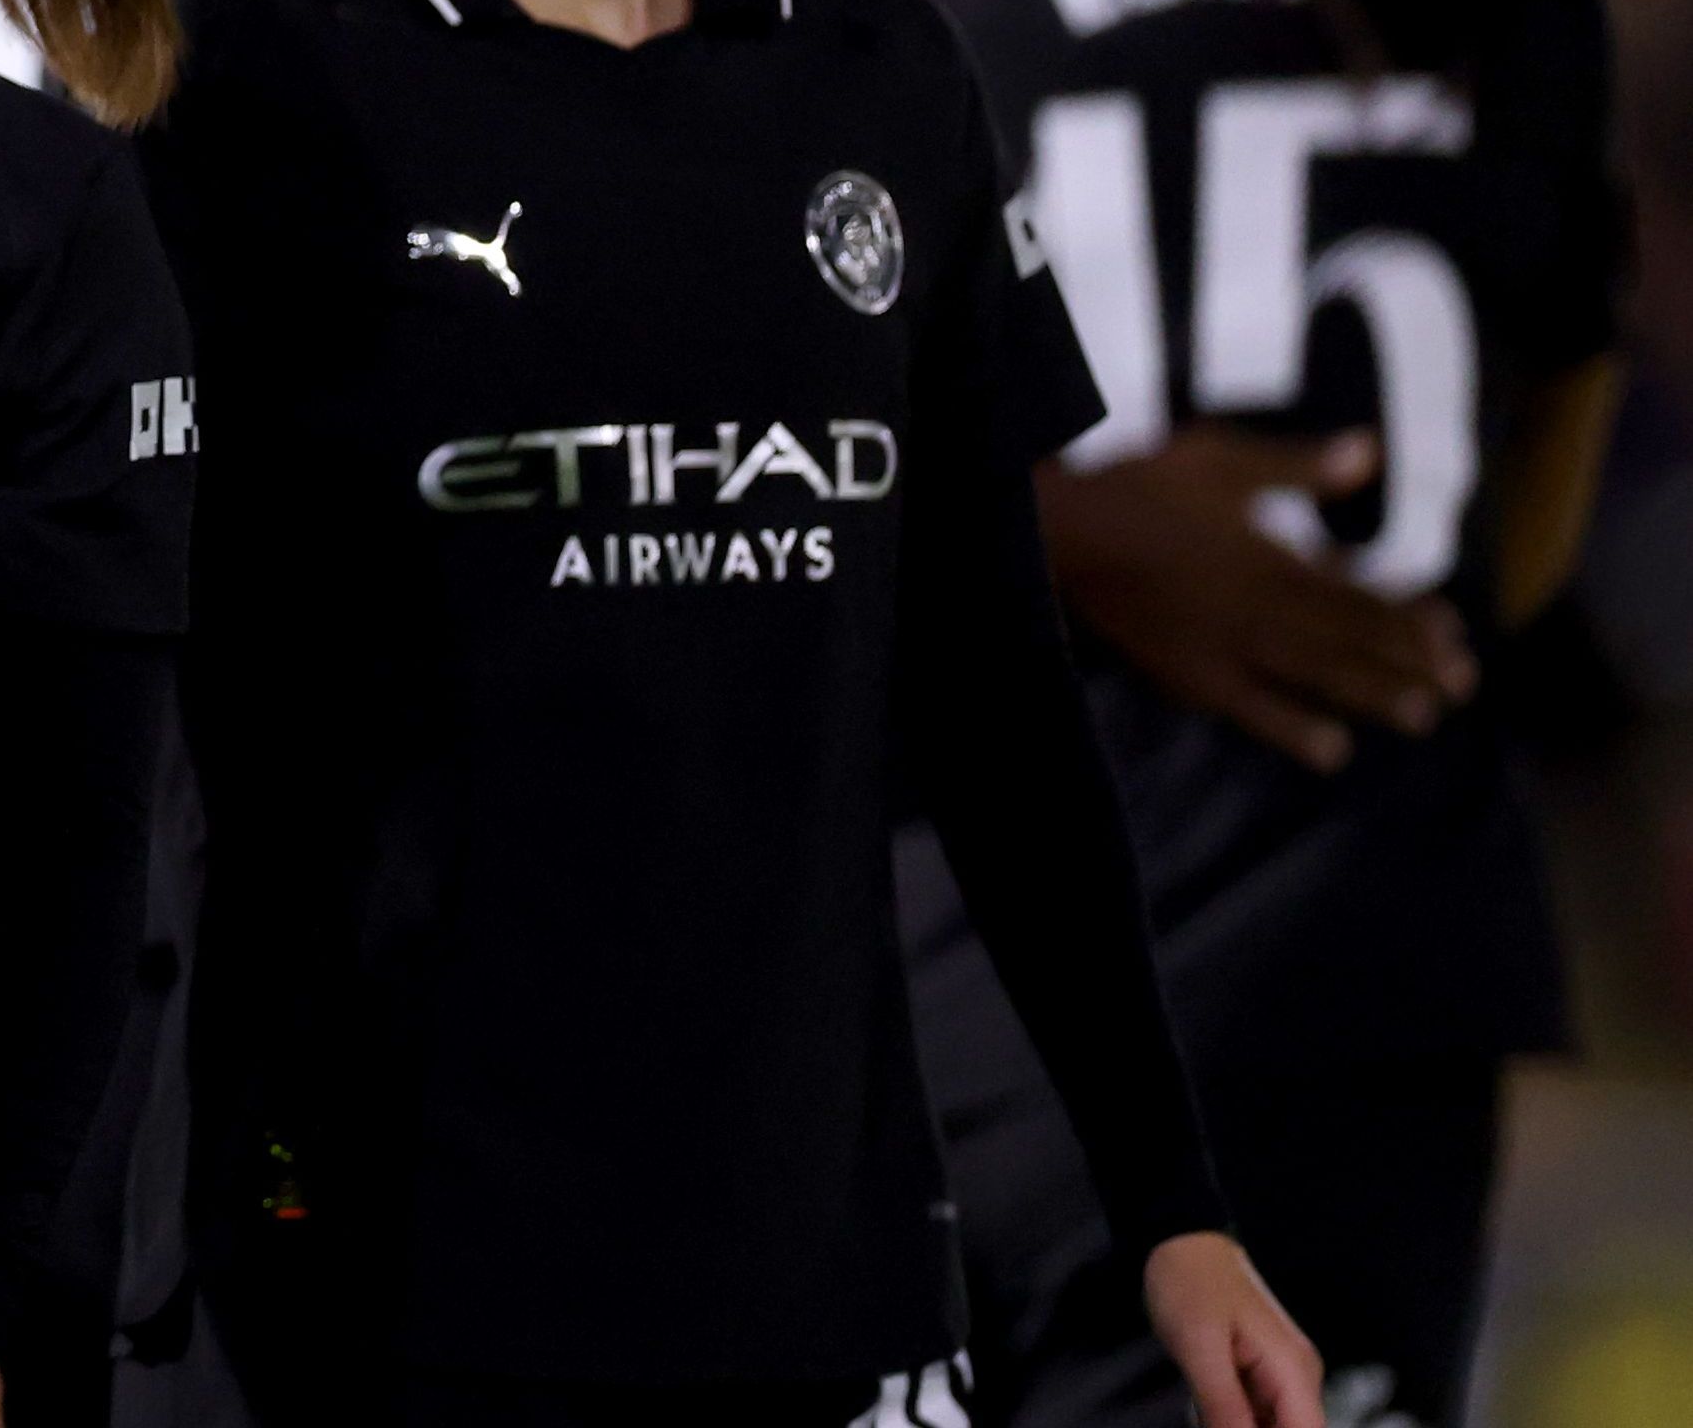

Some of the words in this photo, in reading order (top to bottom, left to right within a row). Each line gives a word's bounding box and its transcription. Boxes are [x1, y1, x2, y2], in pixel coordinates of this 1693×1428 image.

[1031, 75, 1480, 602] 15
[418, 419, 898, 512] ETIHAD
[550, 527, 835, 587] AIRWAYS
